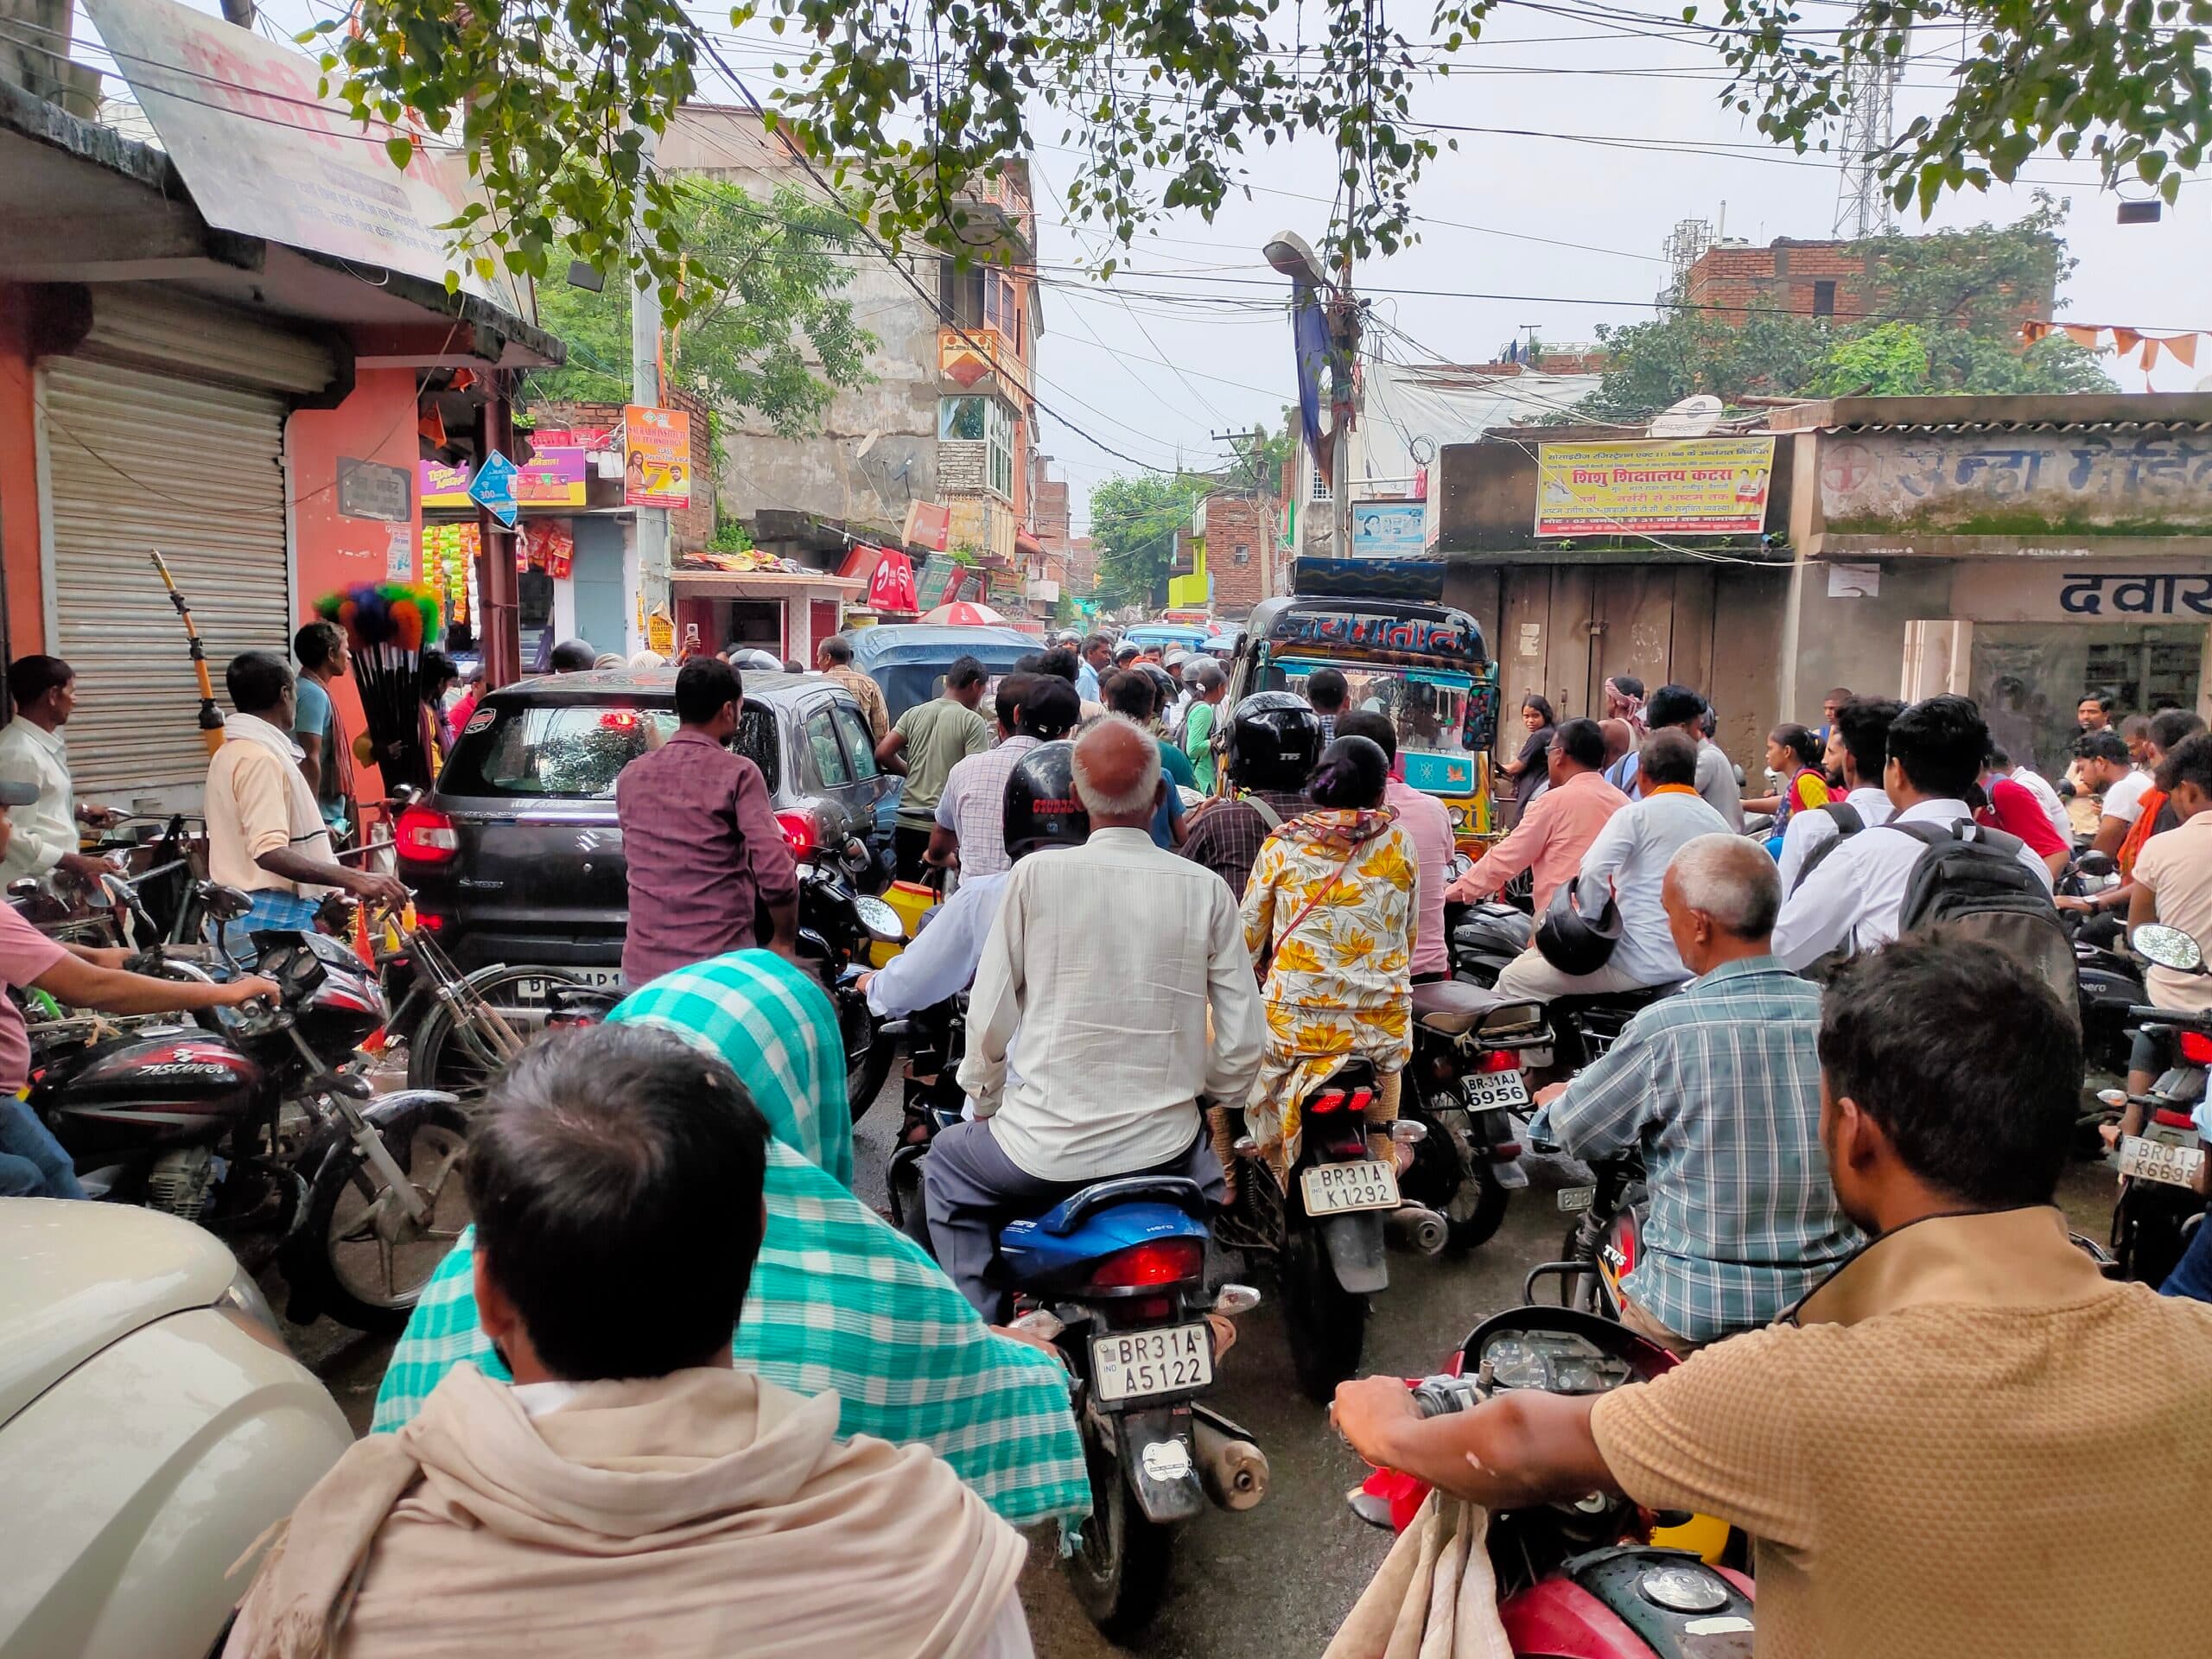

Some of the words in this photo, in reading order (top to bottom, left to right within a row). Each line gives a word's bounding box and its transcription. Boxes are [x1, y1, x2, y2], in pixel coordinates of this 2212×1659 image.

[1573, 468, 1609, 487] शिशु
[1612, 467, 1688, 484] शिक्षालय
[1690, 468, 1734, 481] कटरा
[1468, 1073, 1516, 1090] BR-31AJ
[1469, 1086, 1523, 1106] 6956
[1321, 1165, 1382, 1186] BR31A
[1327, 1184, 1389, 1208] K1292
[1146, 1224, 1174, 1233] Hero
[1603, 1243, 1628, 1267] TVS
[1118, 1330, 1198, 1365] BR31A
[1103, 1363, 1117, 1374] IND
[1126, 1357, 1202, 1393] A5122
